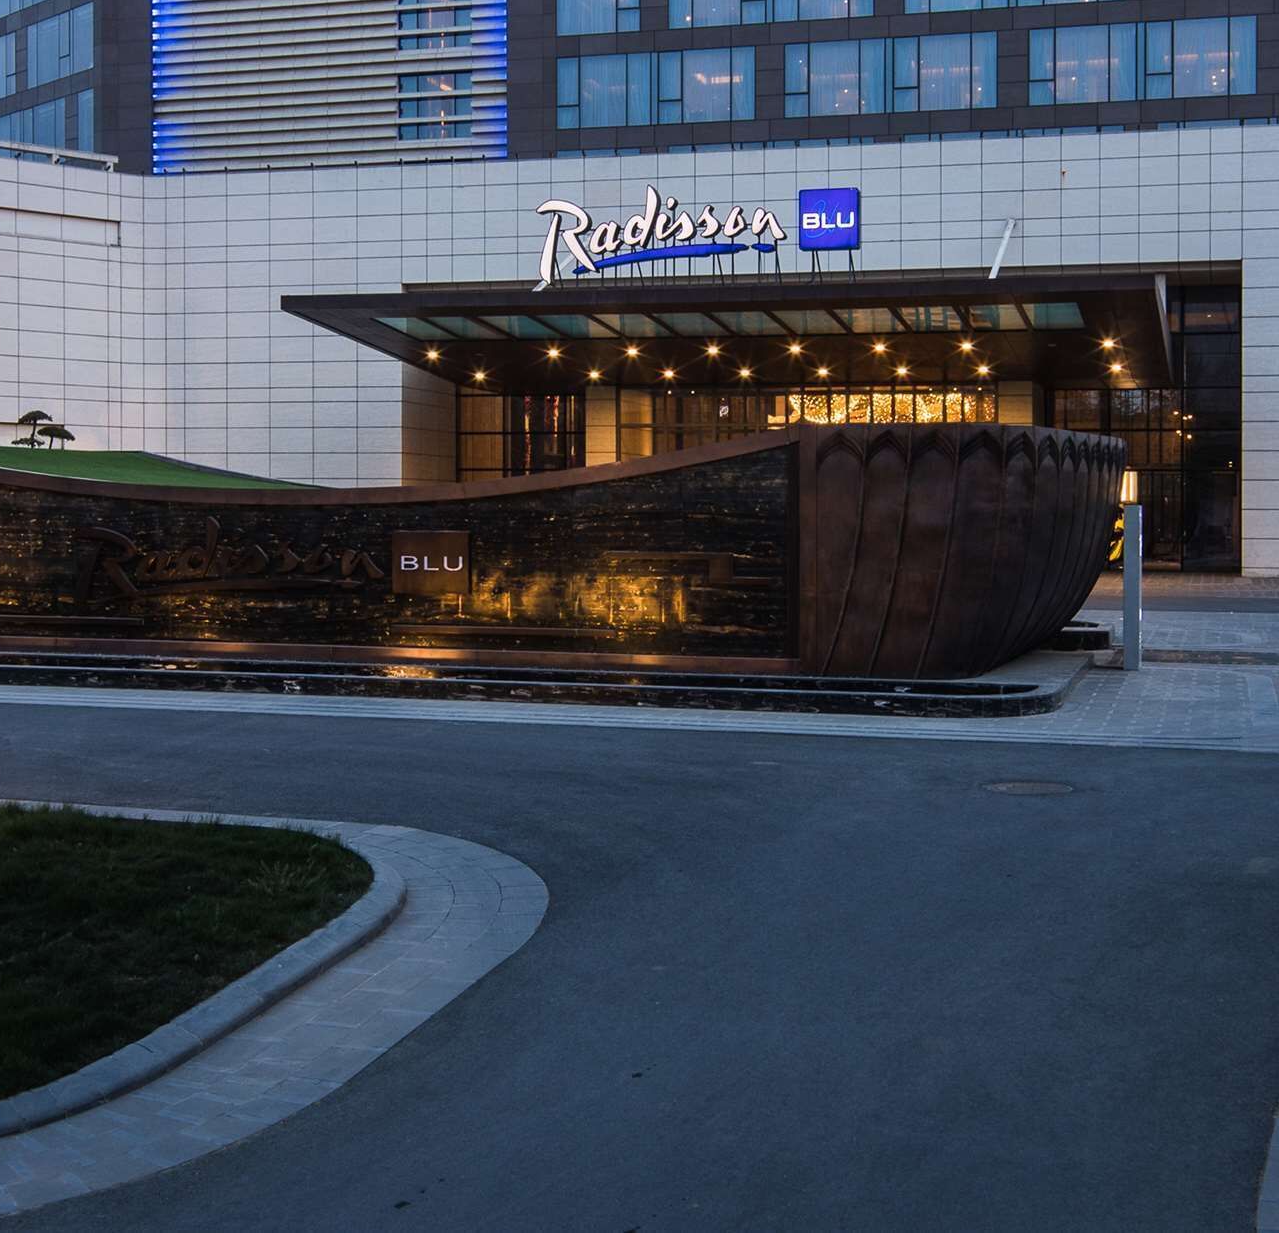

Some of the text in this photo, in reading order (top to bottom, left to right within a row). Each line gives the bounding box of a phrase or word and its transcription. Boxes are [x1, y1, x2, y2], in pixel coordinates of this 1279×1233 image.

[536, 184, 855, 285] Radisson BLU
[400, 555, 463, 571] BLU
